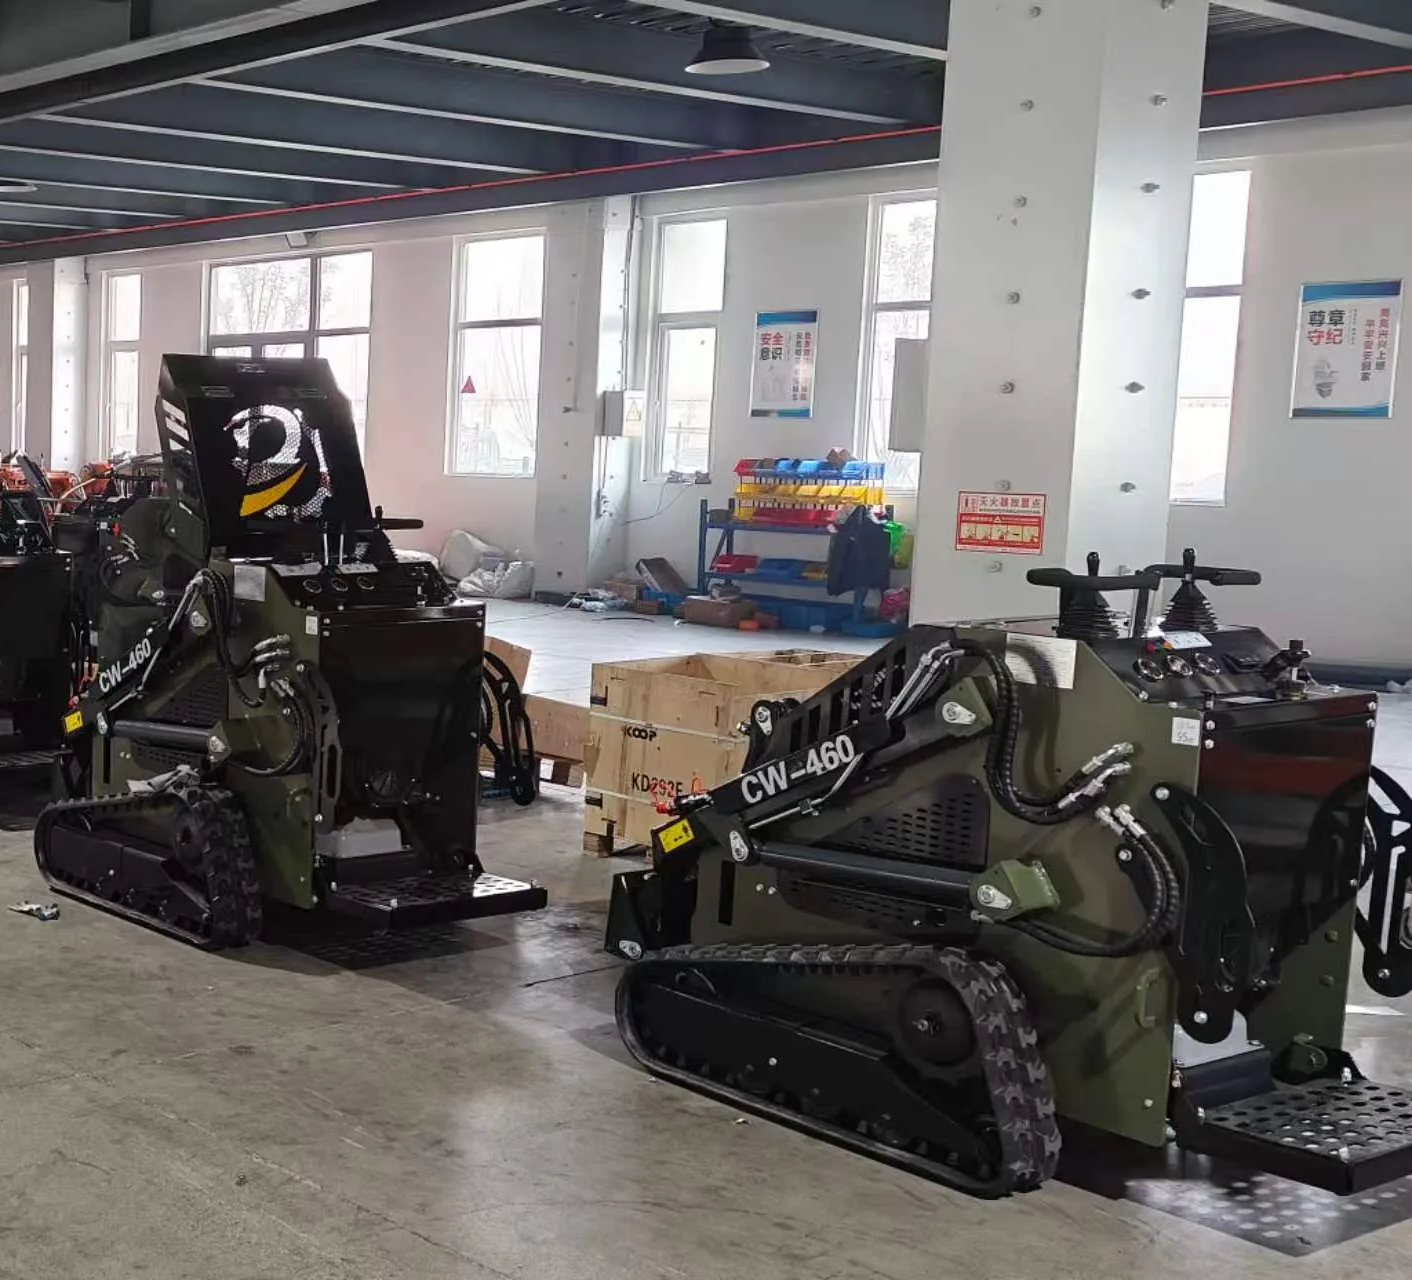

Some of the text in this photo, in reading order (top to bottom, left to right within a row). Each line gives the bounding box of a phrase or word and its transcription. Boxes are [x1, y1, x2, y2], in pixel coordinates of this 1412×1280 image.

[760, 332, 784, 346] 安全
[1307, 328, 1344, 346] 守纪
[99, 638, 151, 692] CW-460
[623, 724, 657, 741] KOOP
[741, 734, 855, 804] CW-460
